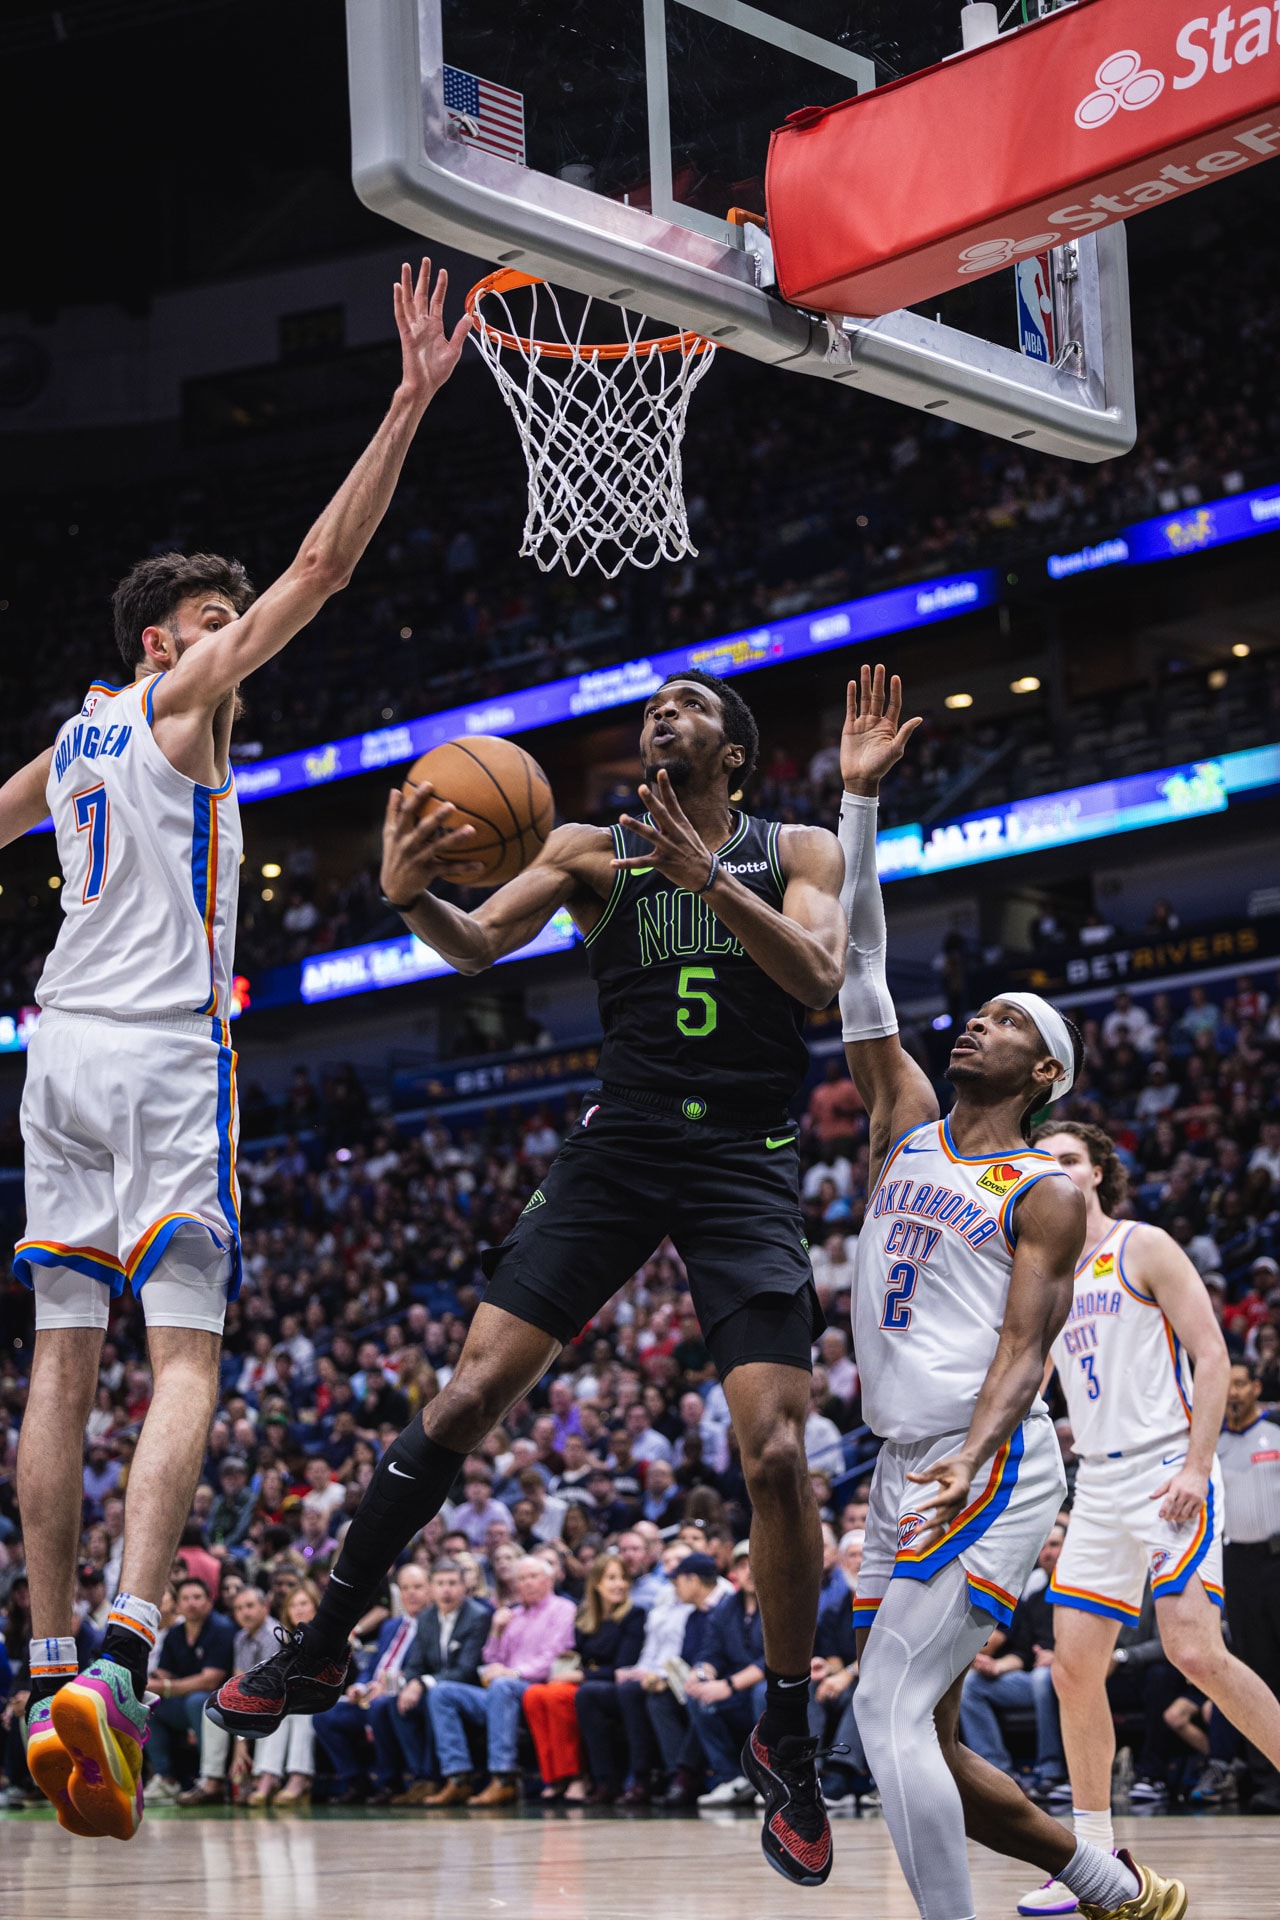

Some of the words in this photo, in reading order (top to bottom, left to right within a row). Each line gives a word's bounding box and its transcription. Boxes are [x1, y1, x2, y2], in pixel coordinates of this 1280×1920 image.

[1173, 0, 1280, 90] Sta
[1024, 330, 1043, 356] NBA
[55, 723, 132, 784] HOLMGEN
[72, 782, 111, 905] 7
[722, 860, 768, 874] ibotta
[637, 887, 745, 967] NOL
[1066, 928, 1257, 985] BETRIVERS
[676, 966, 718, 1037] 5
[873, 1180, 999, 1251] OKLAHOMA
[884, 1220, 942, 1263] CITY
[879, 1259, 918, 1331] 2
[1063, 1320, 1098, 1356] CITY
[1079, 1352, 1101, 1402] 3
